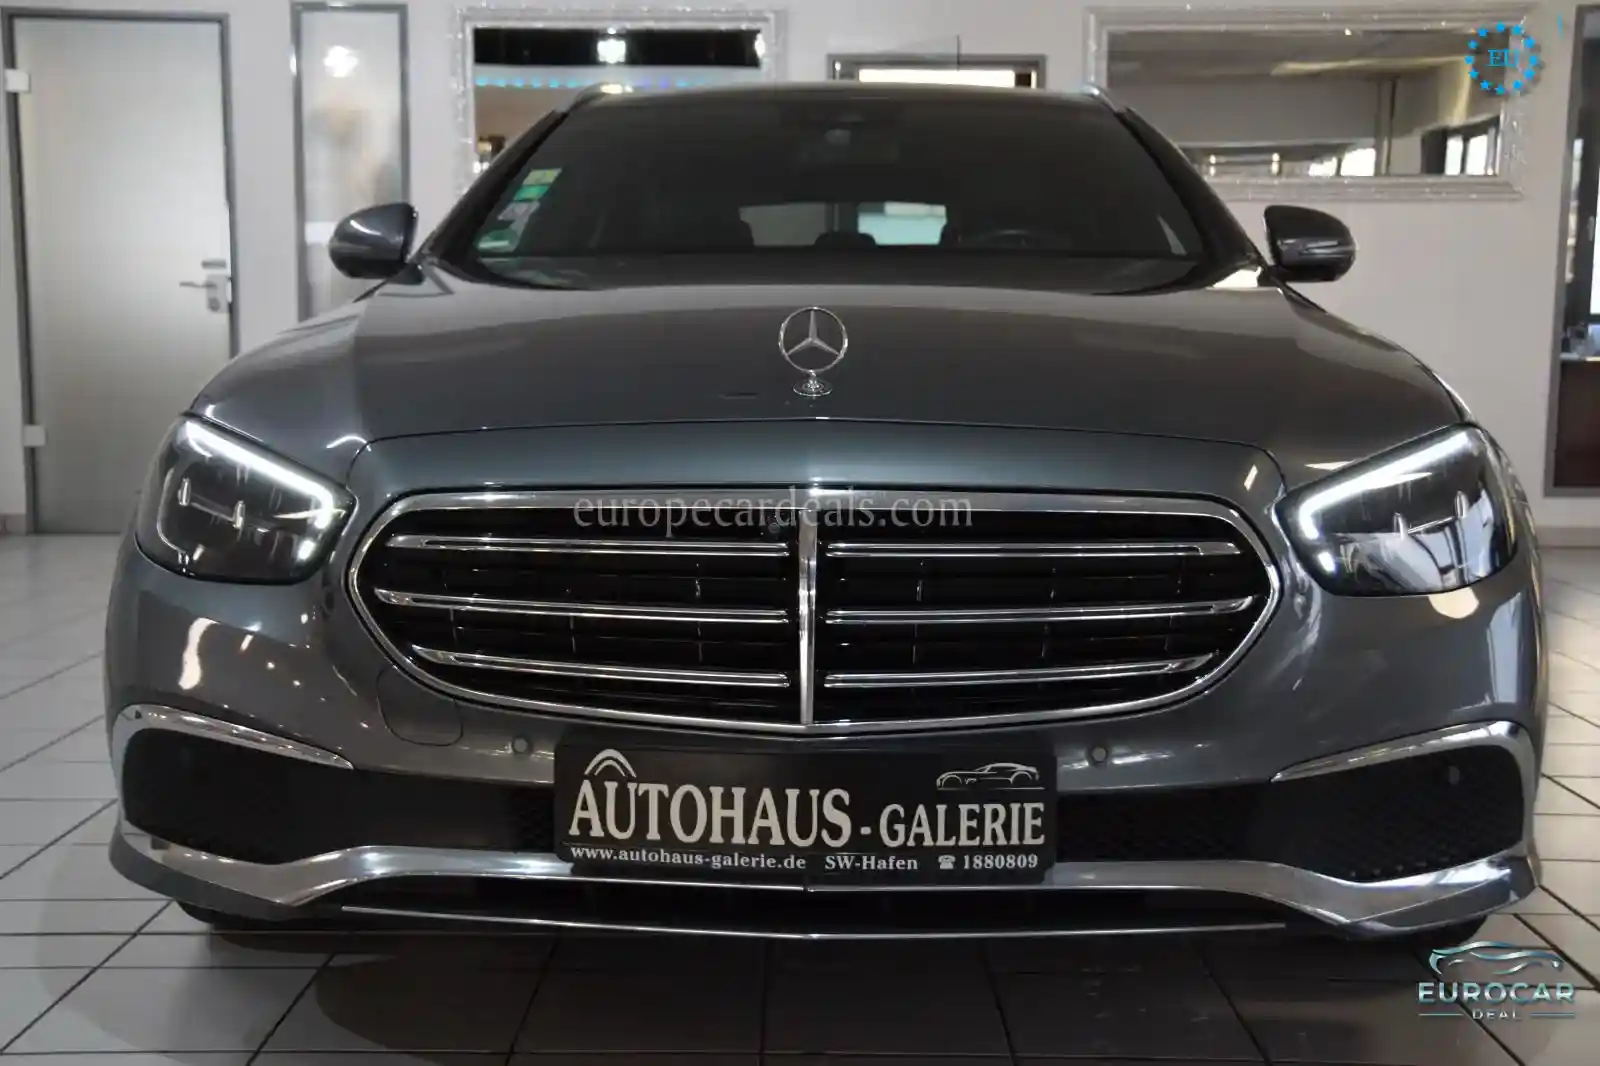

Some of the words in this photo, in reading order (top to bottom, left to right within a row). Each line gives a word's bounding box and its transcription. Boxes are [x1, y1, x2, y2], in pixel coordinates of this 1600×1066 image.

[569, 779, 852, 848] AUTOHAUS
[879, 802, 1045, 848] GALERIE
[570, 845, 807, 870] www.autohaus-galerie.de
[824, 855, 919, 871] SW-Hafen
[963, 854, 1039, 870] 1880809
